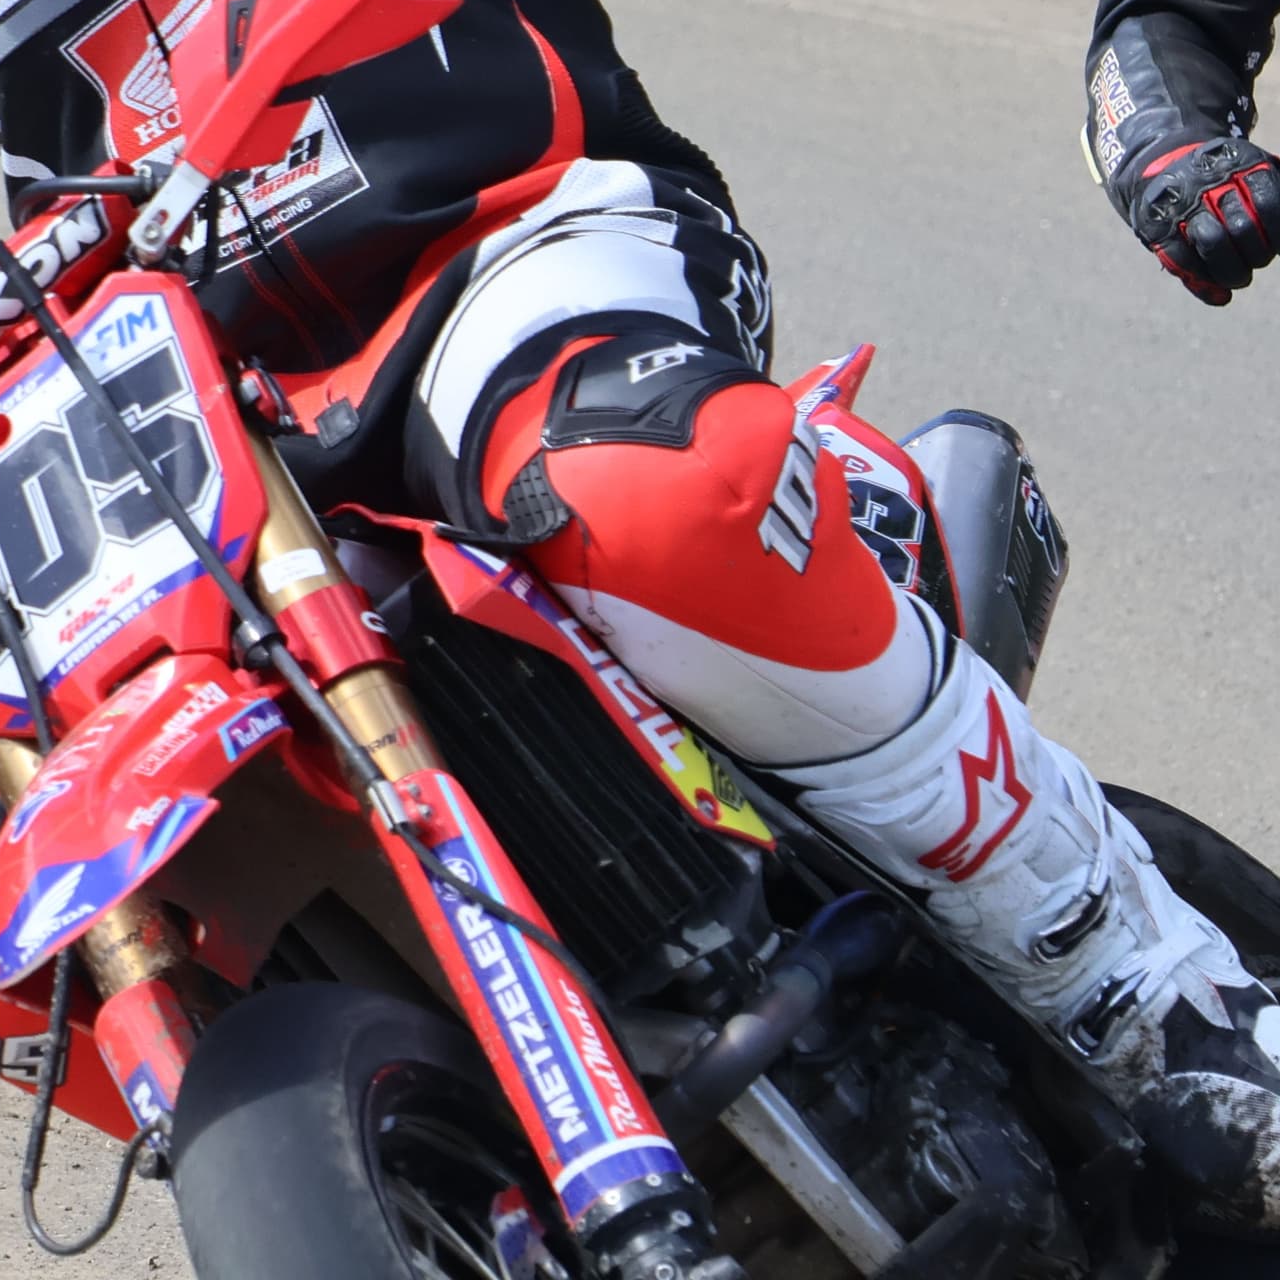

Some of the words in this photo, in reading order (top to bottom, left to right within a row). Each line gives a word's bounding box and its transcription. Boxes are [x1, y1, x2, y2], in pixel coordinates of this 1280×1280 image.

[261, 197, 313, 232] RACING
[455, 901, 589, 1146] METZELER
[557, 977, 644, 1135] RedMoto
